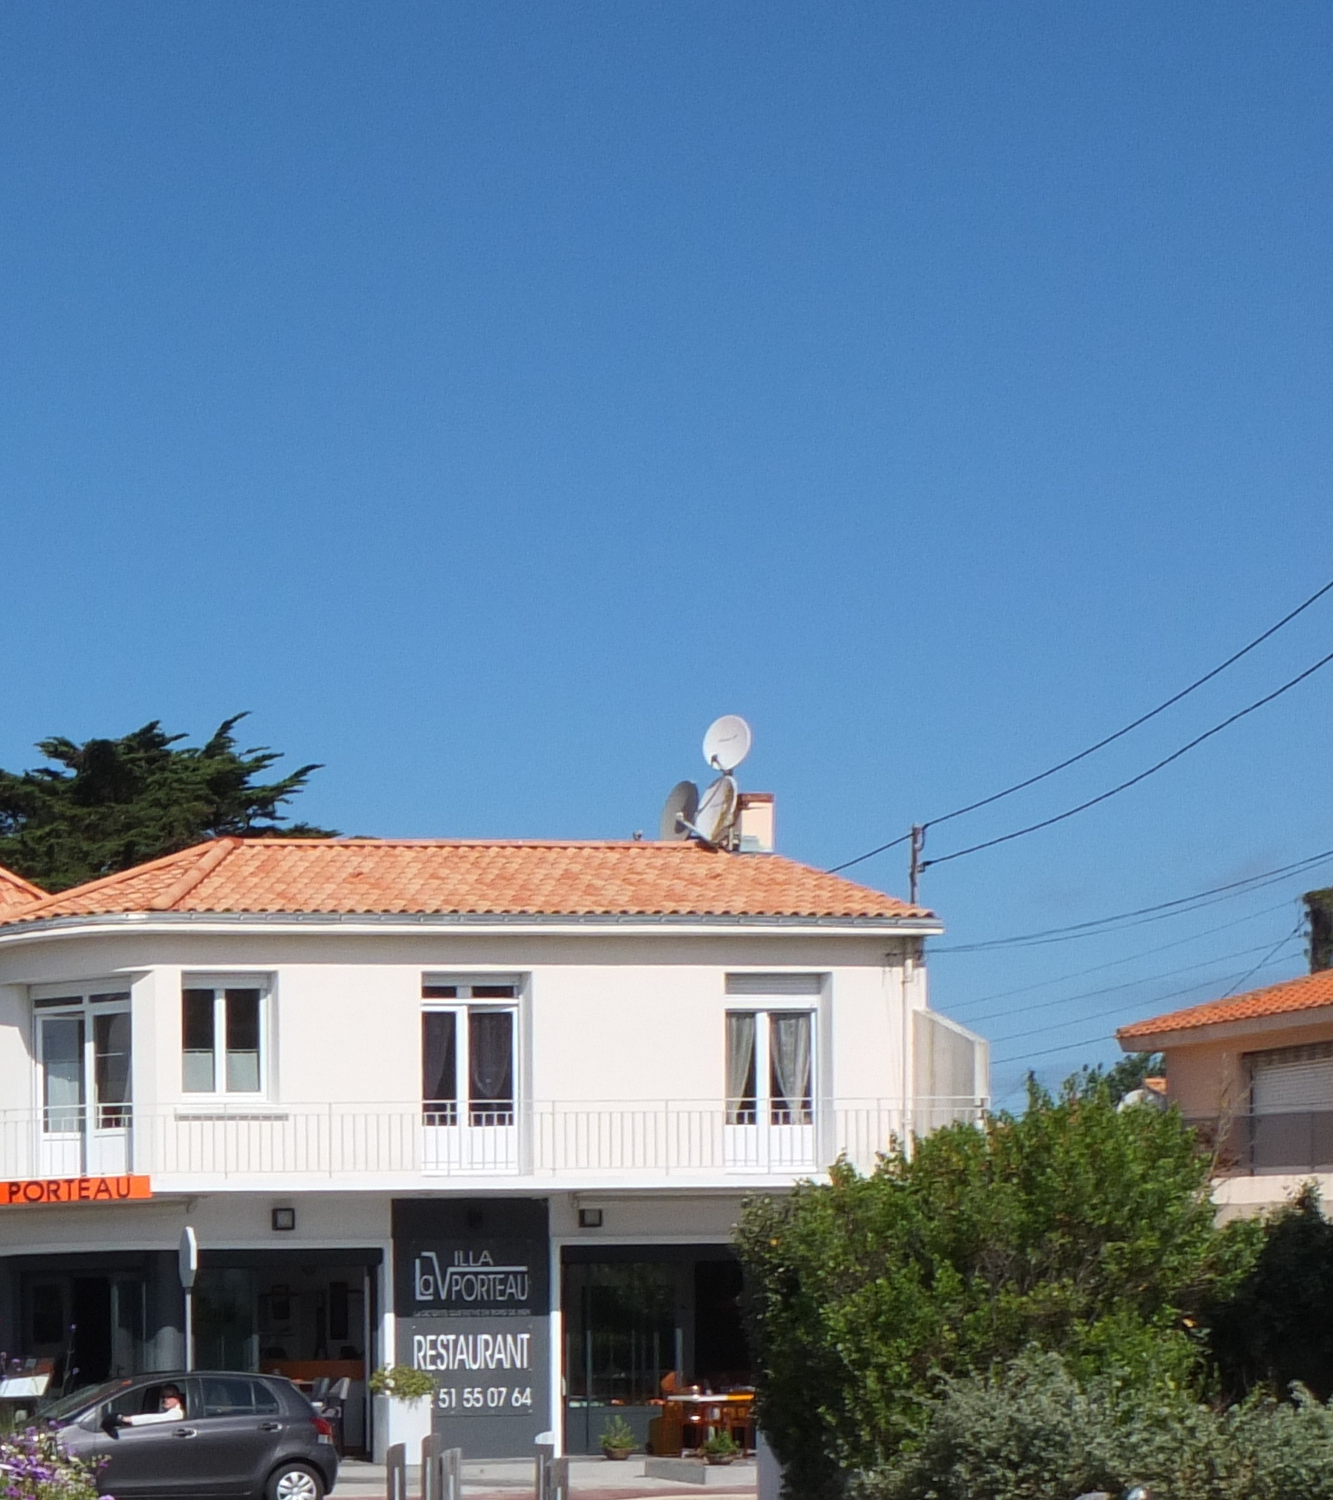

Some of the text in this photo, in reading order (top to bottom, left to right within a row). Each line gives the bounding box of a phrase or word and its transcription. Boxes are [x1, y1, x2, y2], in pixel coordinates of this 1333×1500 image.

[7, 1177, 132, 1203] PORTEAU
[451, 1273, 529, 1301] PORTEAU
[413, 1333, 531, 1370] RESTAURANT
[438, 1388, 456, 1408] 51
[462, 1387, 484, 1408] 55
[487, 1386, 508, 1407] 07
[511, 1386, 532, 1407] 64
